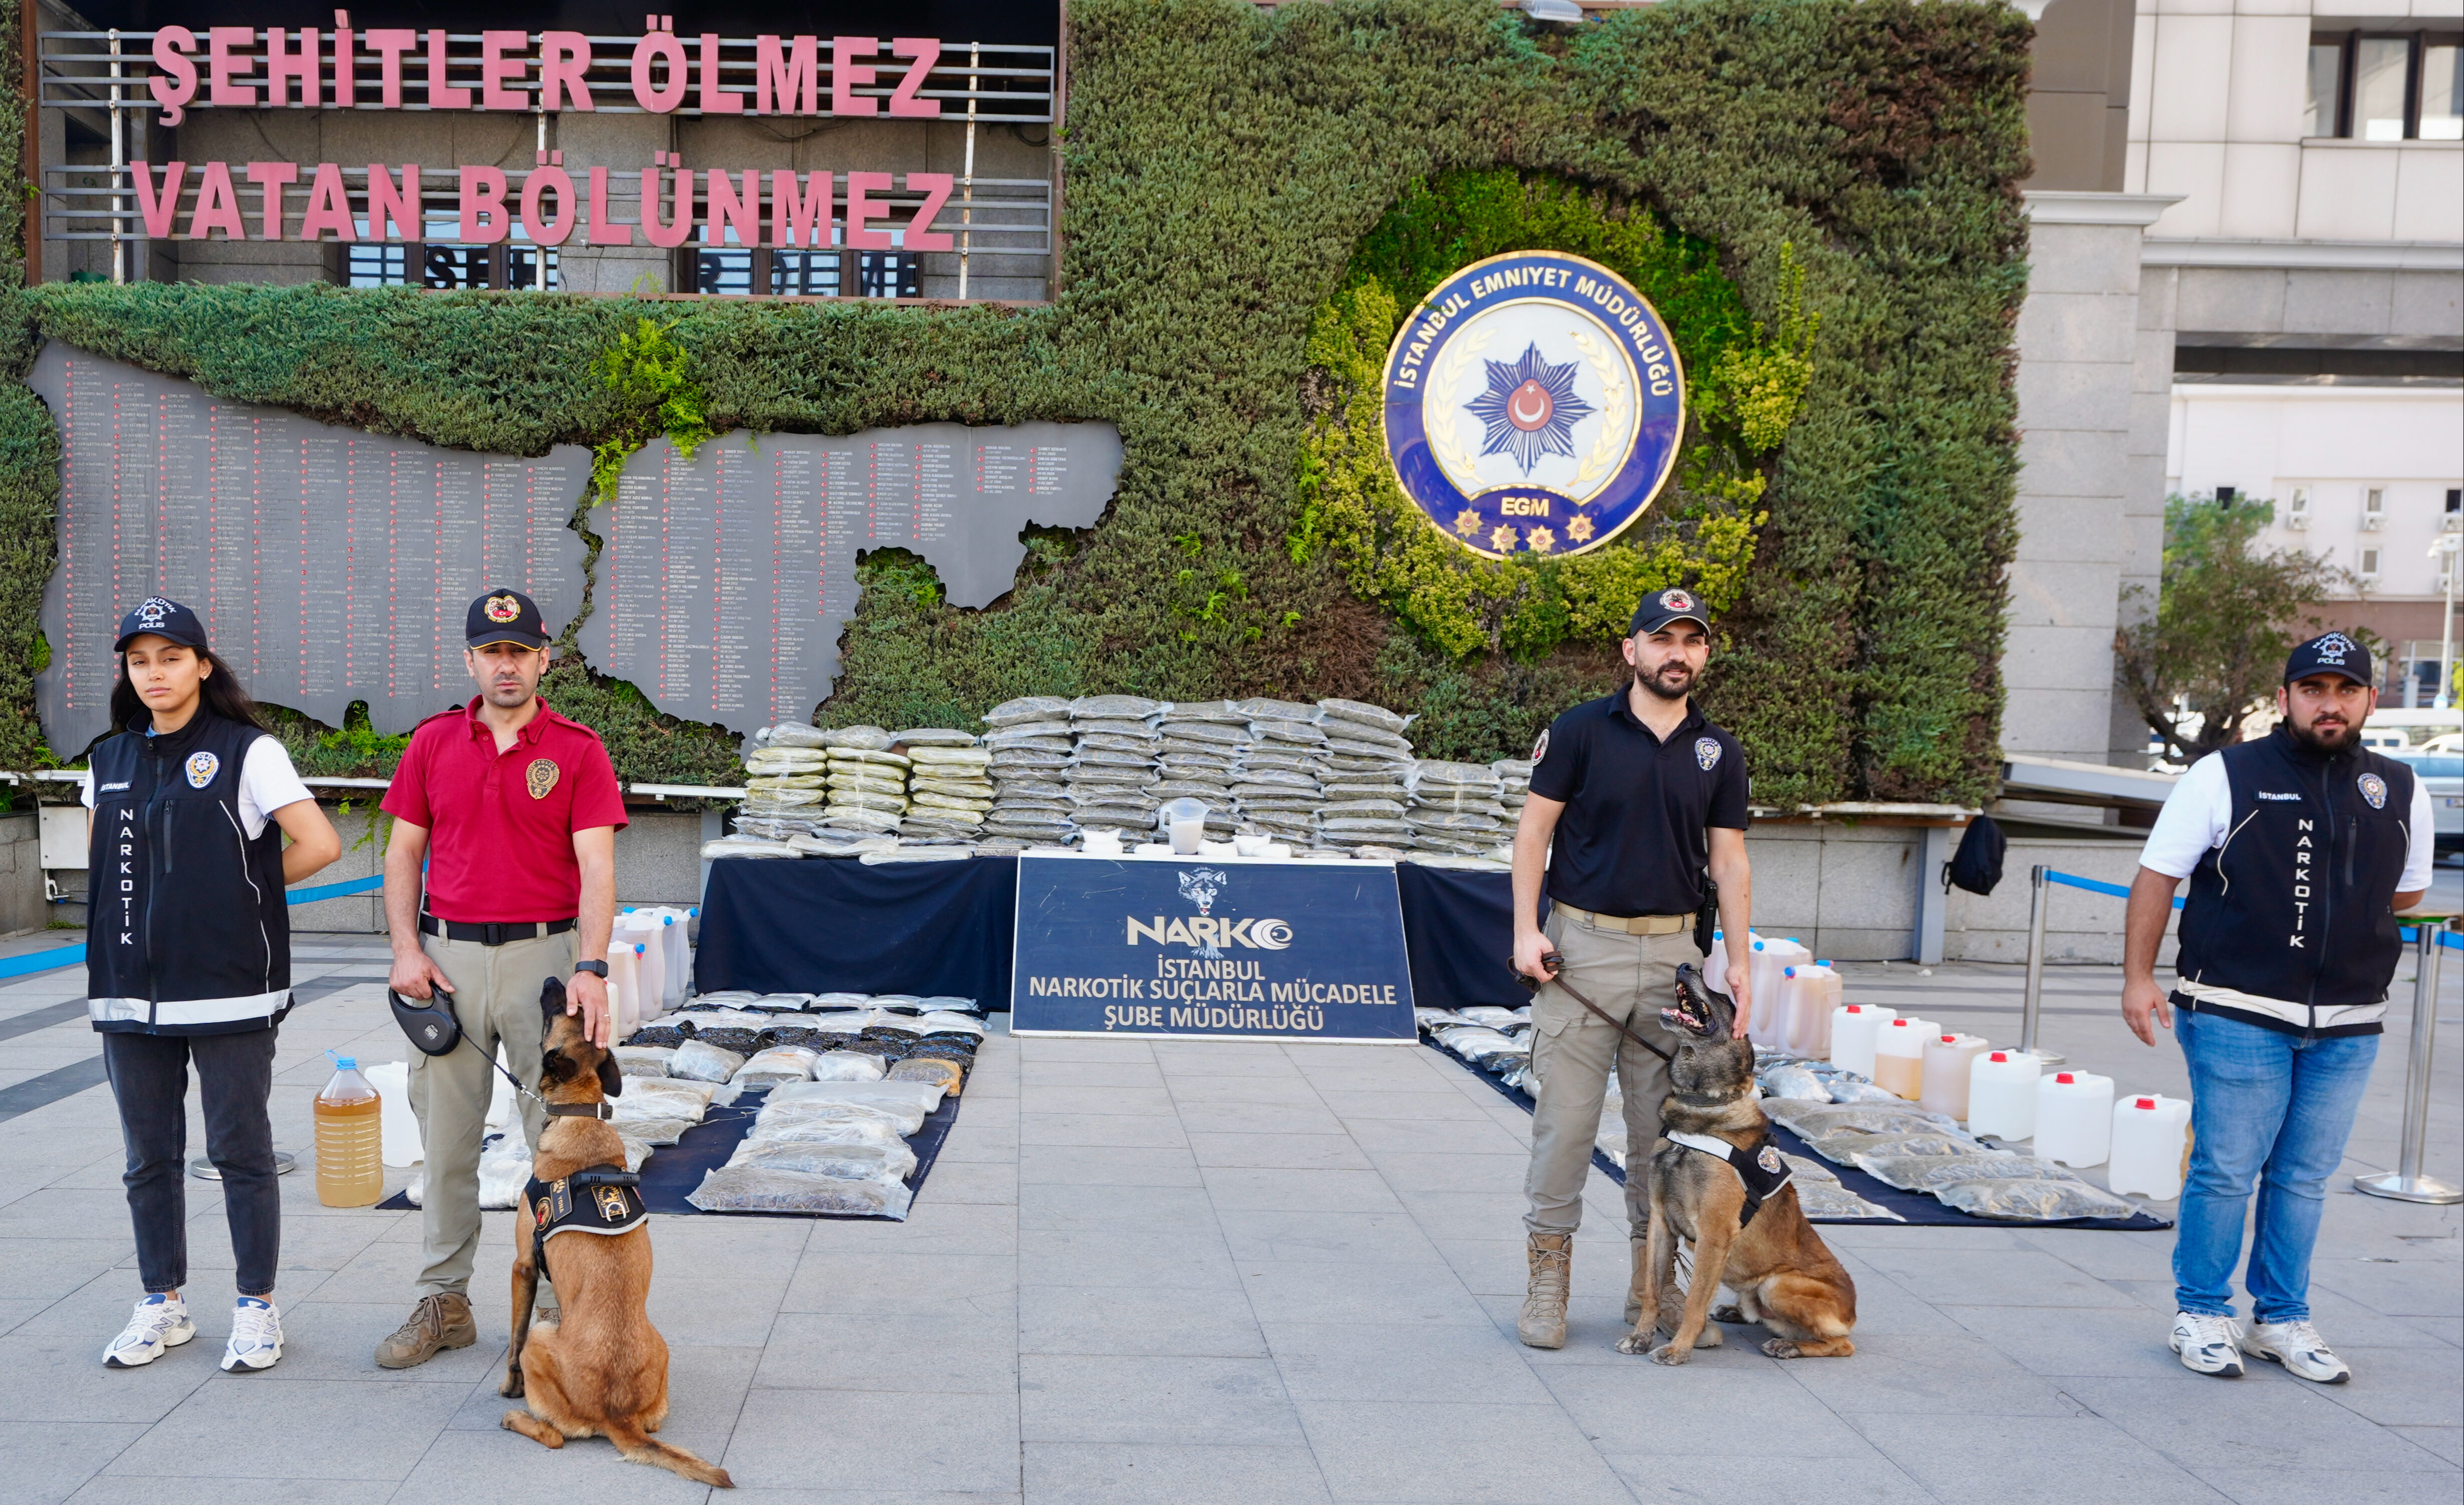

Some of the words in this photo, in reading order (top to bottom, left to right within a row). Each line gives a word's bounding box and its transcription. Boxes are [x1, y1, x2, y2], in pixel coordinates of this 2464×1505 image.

[148, 9, 595, 127] ŞEHİTLER
[631, 14, 941, 119] ÖLMEZ
[129, 160, 420, 243] VATAN
[459, 149, 954, 252] BÖLÜNMEZ
[1393, 292, 1470, 389] İSTANBUL
[1470, 265, 1572, 299] EMNİYET
[1573, 275, 1675, 397] MÜDÜRLÜĞÜ
[1500, 496, 1550, 517] EGM
[120, 809, 134, 945] NARKOTİK
[2290, 818, 2314, 949] NARKOTİK
[1029, 974, 1144, 999] NARKOTİK
[1149, 979, 1265, 1006] SUÇLARLA
[1270, 978, 1397, 1005] MÜCADELE
[1157, 954, 1266, 981] İSTANBUL
[1103, 1005, 1164, 1031] ŞUBE
[1170, 1002, 1324, 1031] MÜDÜRLÜĞÜ
[556, 1195, 564, 1214] YONA
